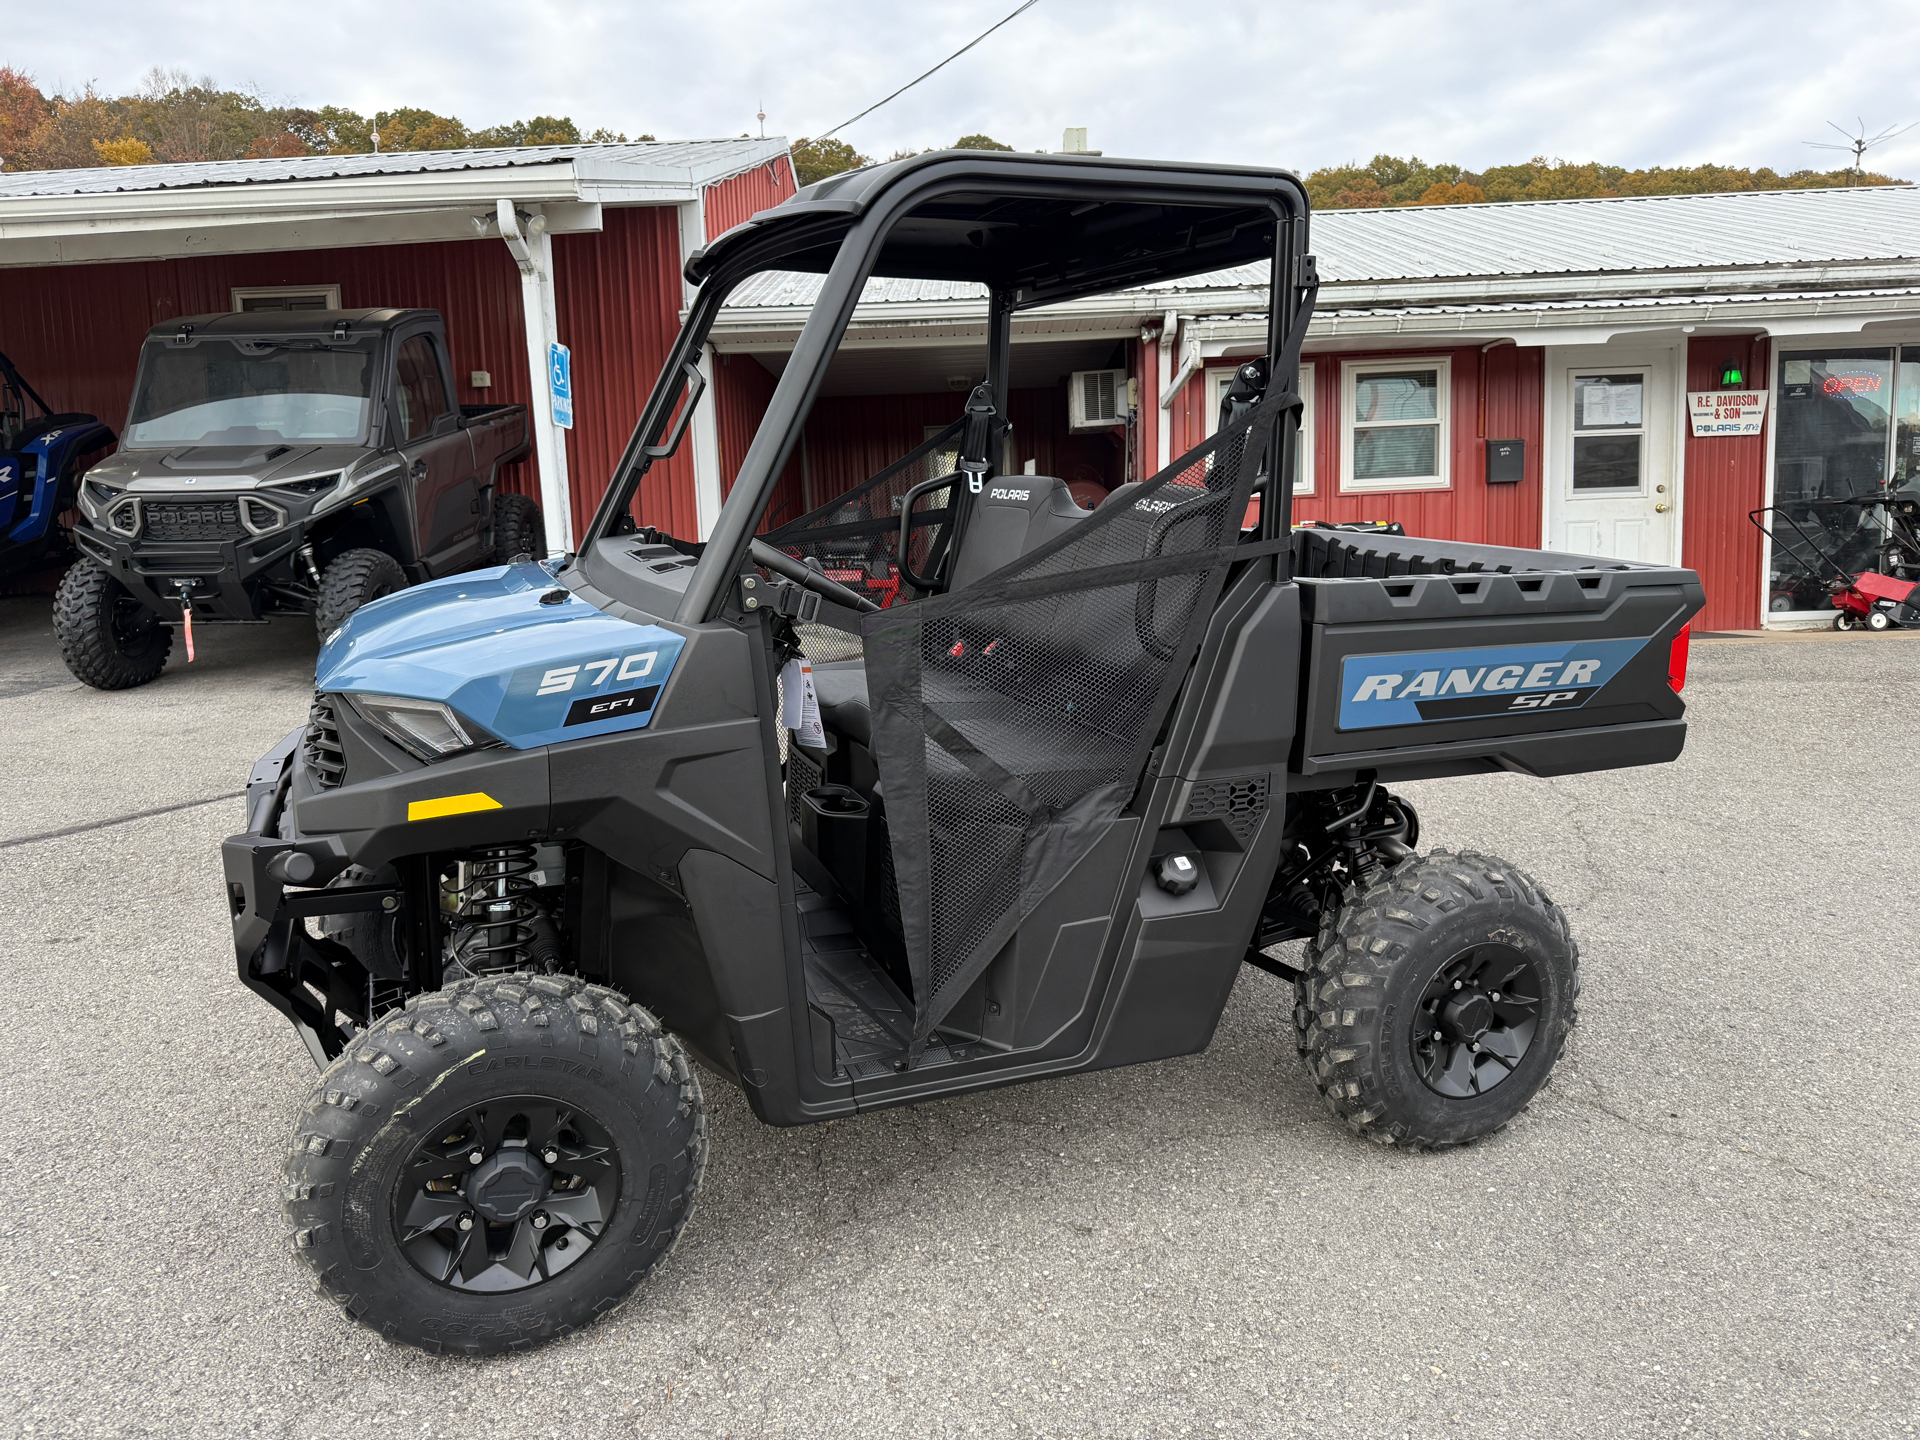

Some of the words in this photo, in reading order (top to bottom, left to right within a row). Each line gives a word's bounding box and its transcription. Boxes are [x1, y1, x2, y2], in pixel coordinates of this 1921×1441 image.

[1823, 377, 1882, 393] OPEN
[551, 394, 572, 415] PARKING
[1697, 396, 1713, 408] R.E.
[1716, 394, 1759, 407] DAVIDSON
[1714, 408, 1721, 420] &
[1723, 407, 1741, 420] SON
[1696, 423, 1741, 433] POLARIS
[364, 460, 393, 476] 1500
[990, 488, 1031, 501] POLARIS
[147, 511, 237, 524] POLARIS
[453, 527, 475, 543] POLARIS
[536, 651, 658, 696] 570
[1352, 659, 1601, 702] RANGER
[590, 698, 635, 714] EFI
[1508, 691, 1579, 710] SP
[1379, 1003, 1401, 1097] CARLSTAR
[466, 1055, 605, 1084] CARLSTAR
[419, 1311, 547, 1337] AT489
